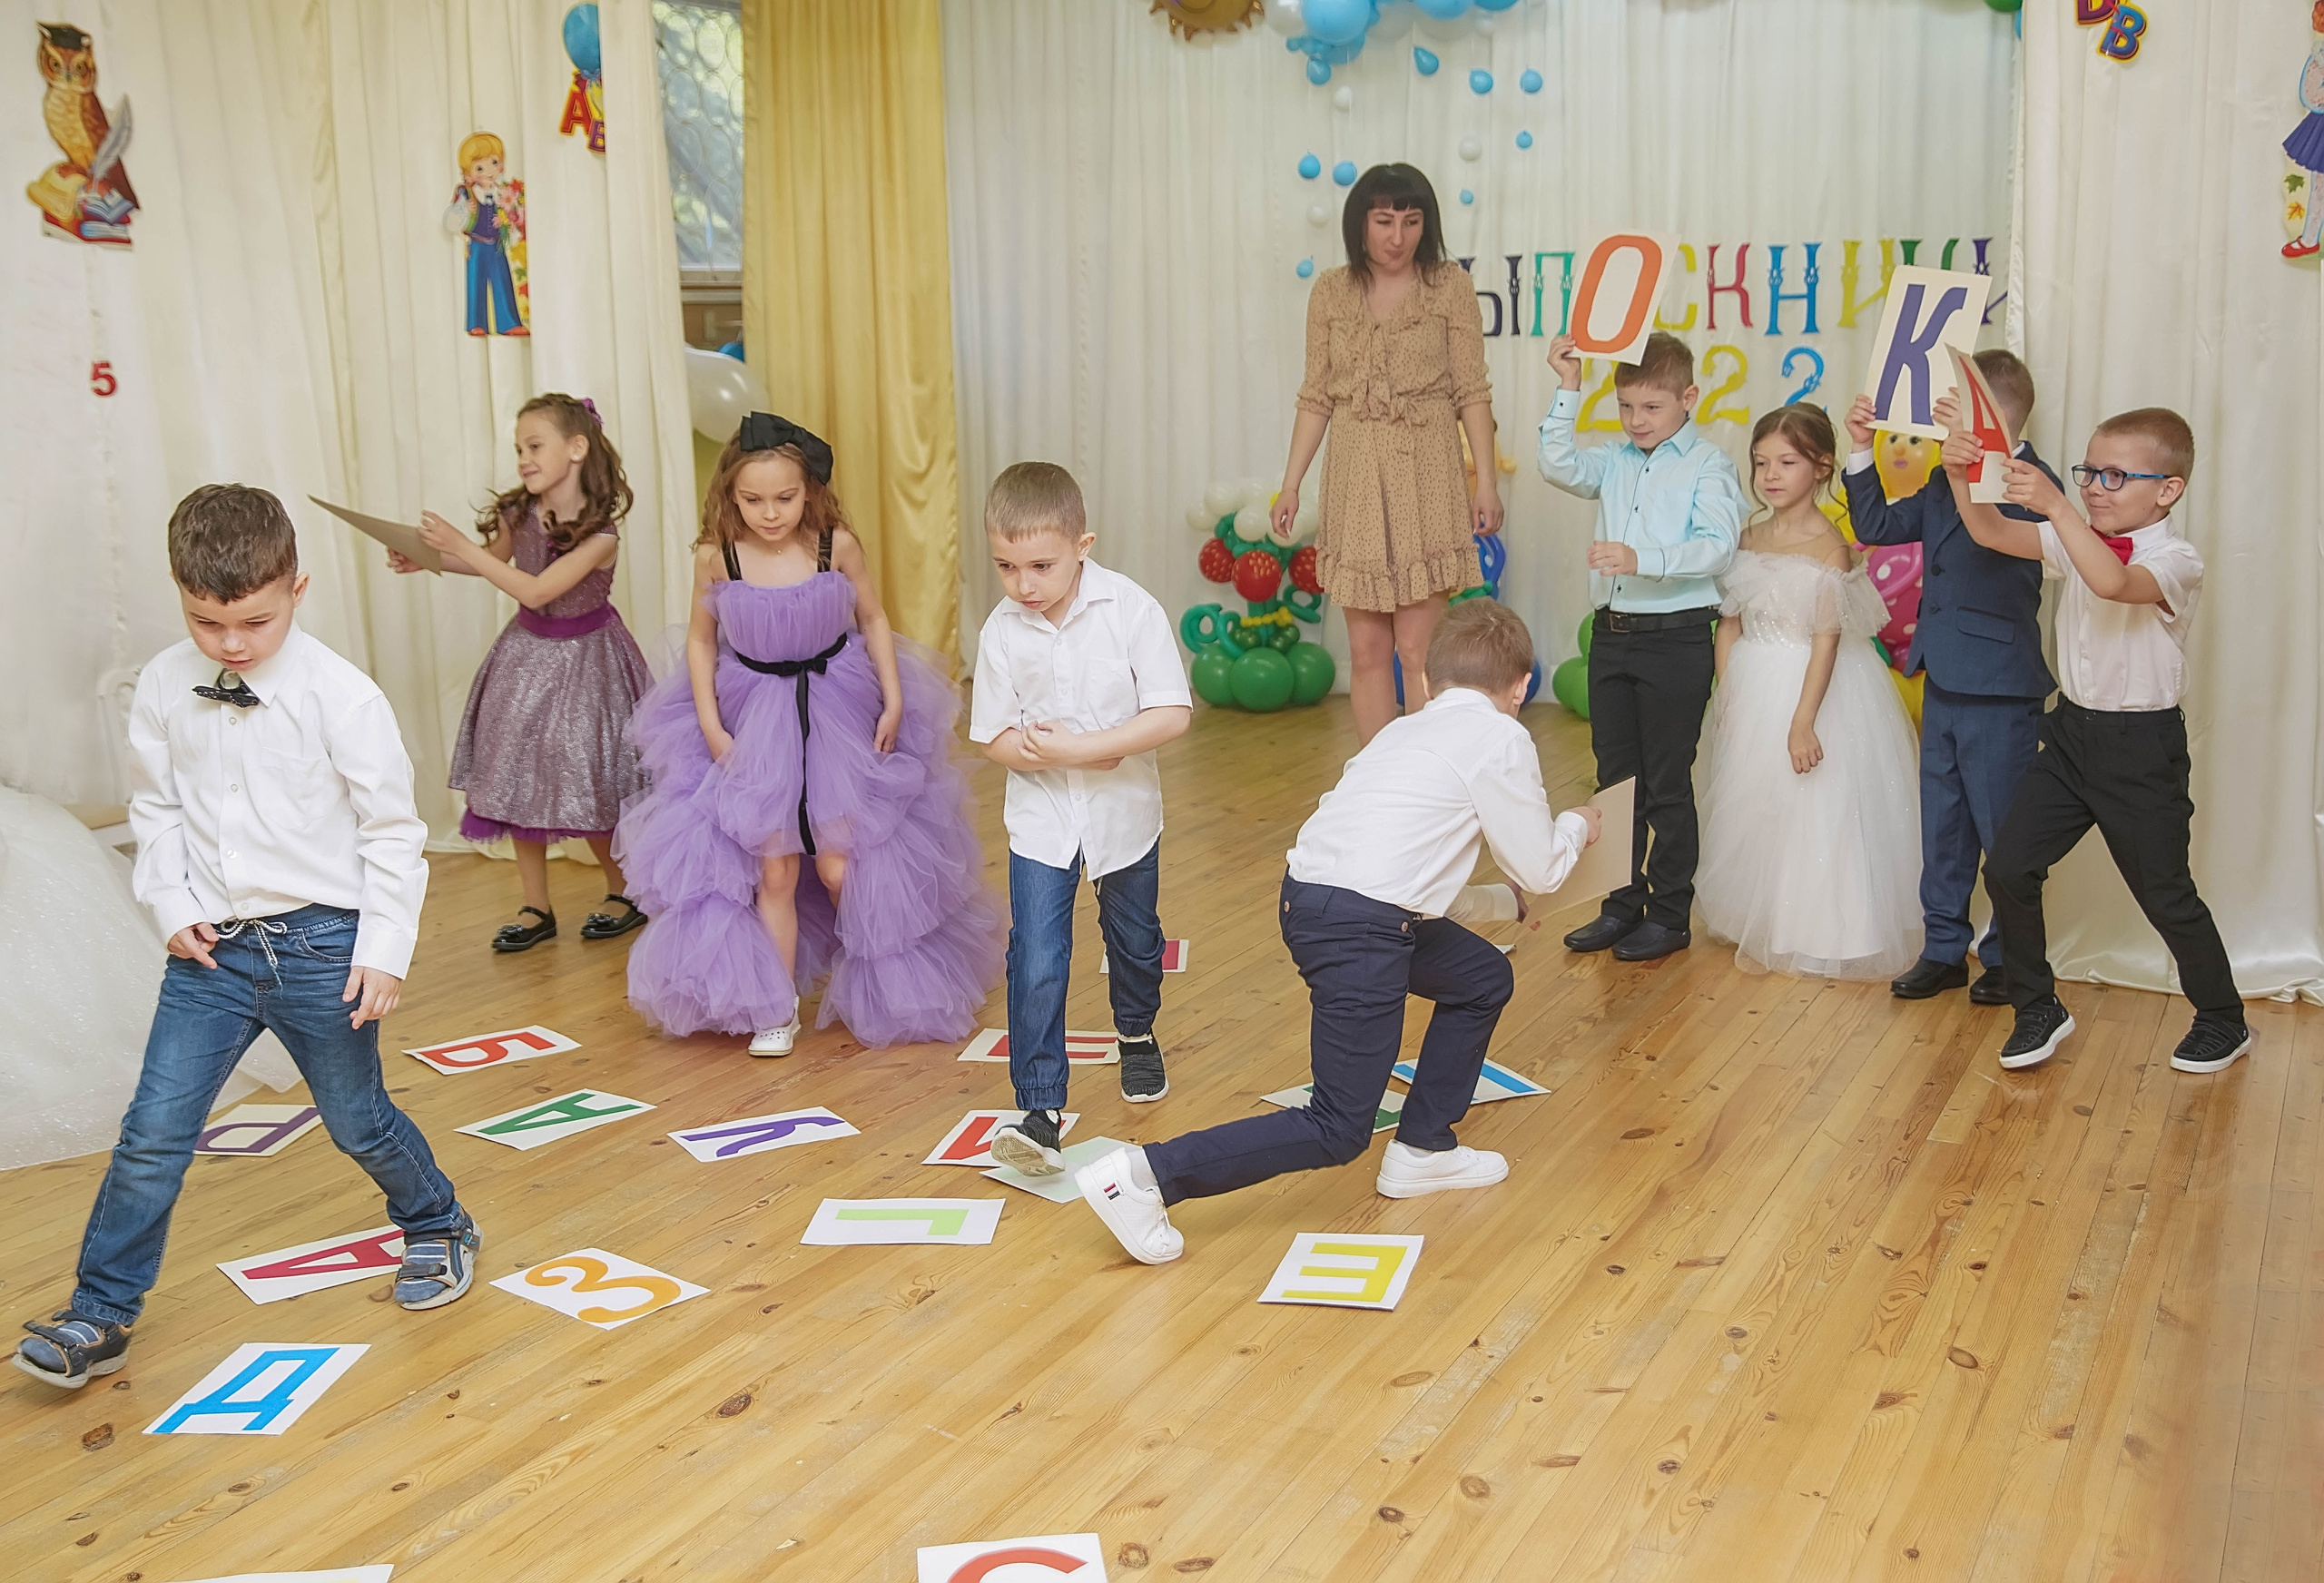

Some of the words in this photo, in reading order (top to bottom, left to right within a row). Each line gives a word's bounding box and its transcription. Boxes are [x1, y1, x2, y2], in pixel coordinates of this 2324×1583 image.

[1571, 233, 1662, 354] О
[91, 360, 117, 397] 5
[1874, 282, 1968, 427] К
[1966, 355, 2012, 484] А
[476, 1092, 643, 1136] А
[241, 1228, 405, 1281] А
[153, 1346, 341, 1434] Д
